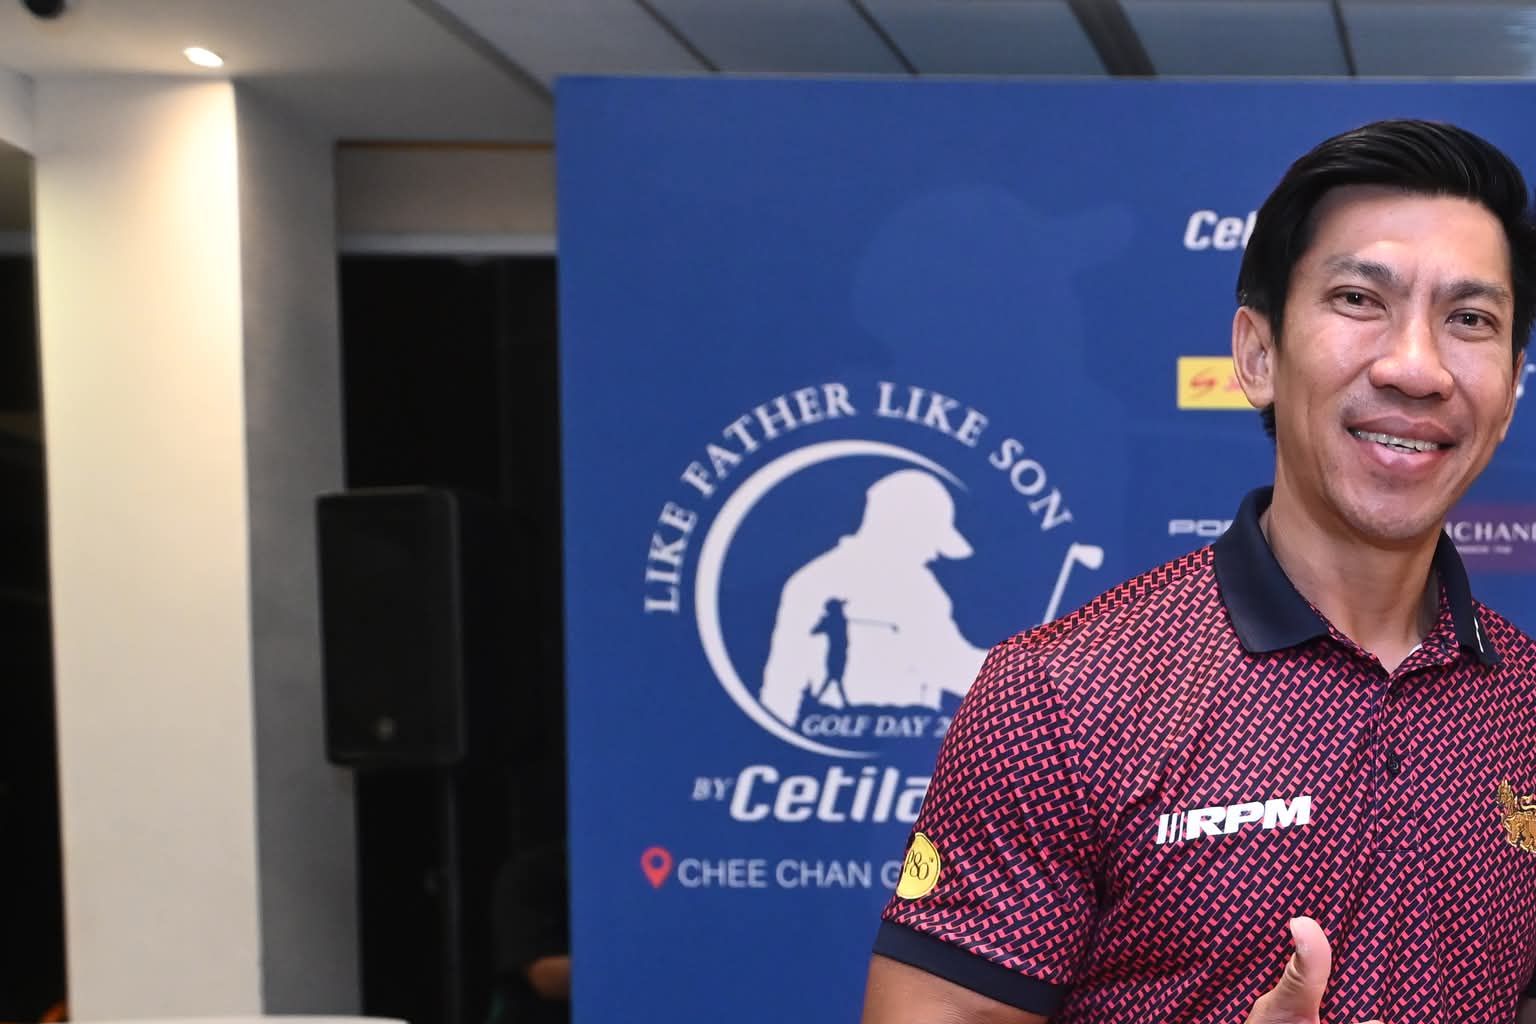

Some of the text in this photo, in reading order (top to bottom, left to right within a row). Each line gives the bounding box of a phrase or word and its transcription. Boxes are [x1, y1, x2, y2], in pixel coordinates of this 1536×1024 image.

[643, 380, 1074, 615] LIKE FATHER LIKE SON
[802, 713, 867, 737] GOLF
[875, 714, 928, 738] DAY
[692, 777, 735, 801] BY
[677, 858, 768, 890] CHEE
[775, 858, 873, 890] CHAN
